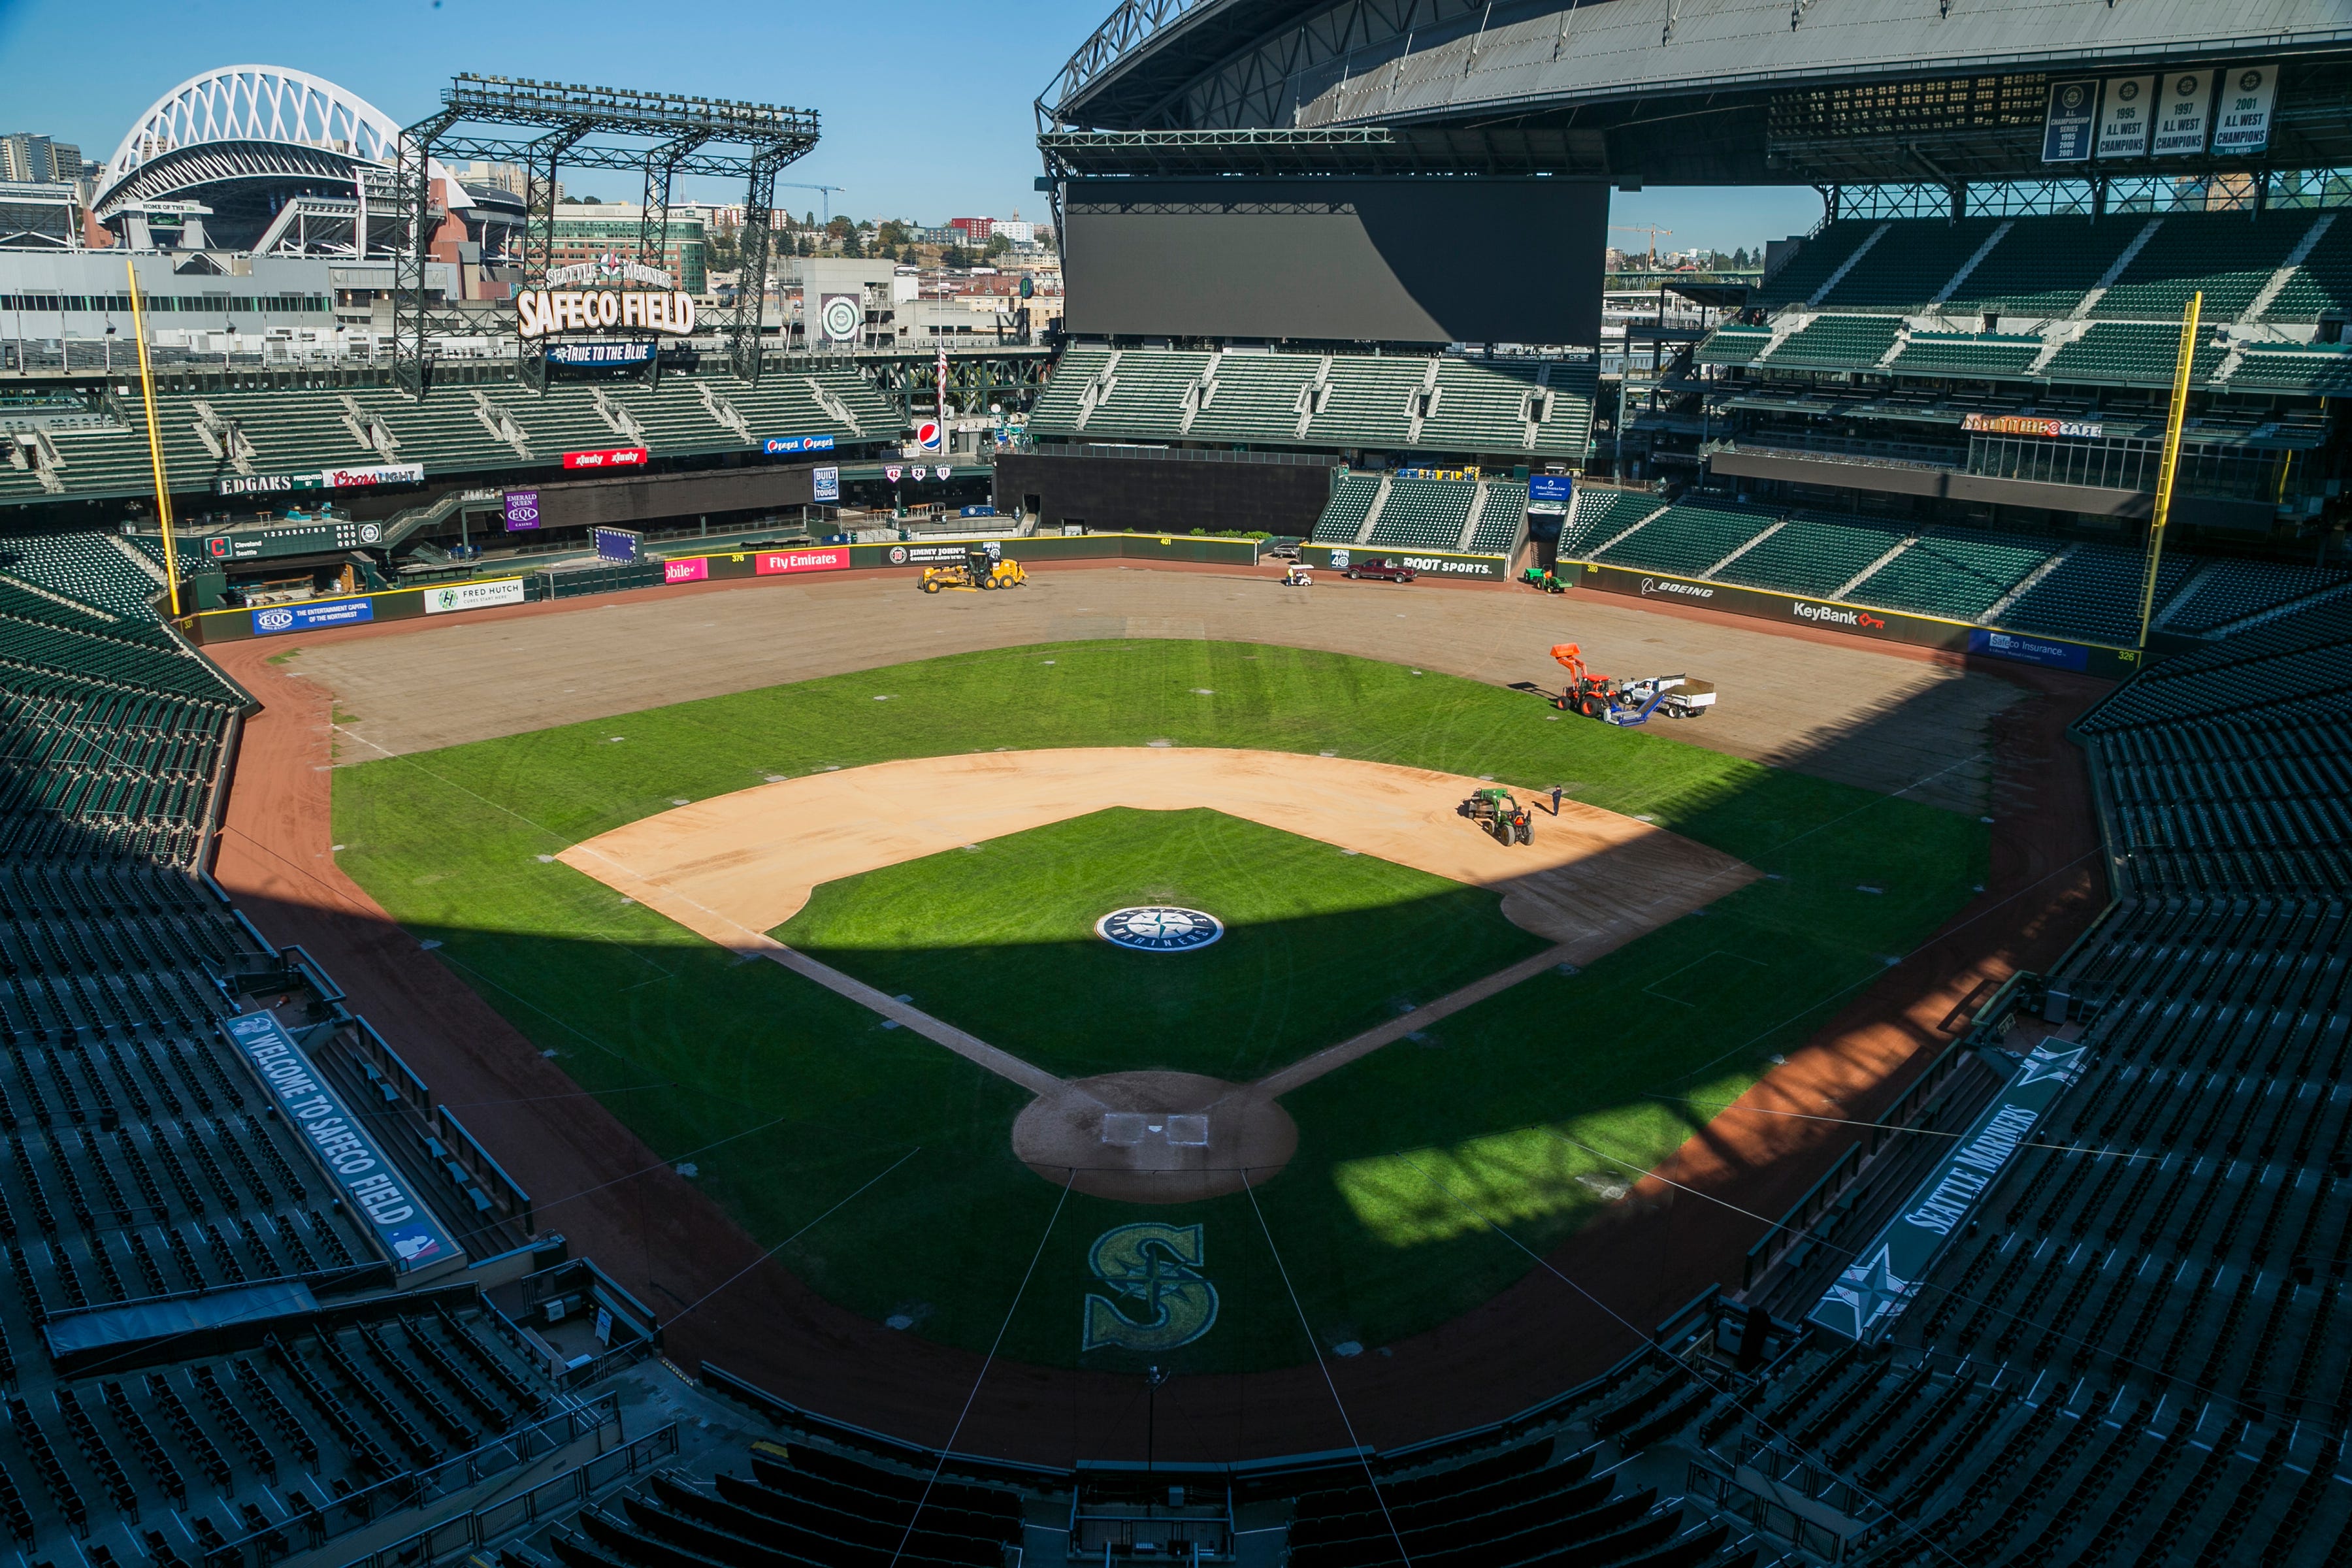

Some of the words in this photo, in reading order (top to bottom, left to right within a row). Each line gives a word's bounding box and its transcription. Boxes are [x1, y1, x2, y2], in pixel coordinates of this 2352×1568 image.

[2174, 103, 2193, 115] 1997
[2235, 98, 2257, 110] 2001
[2117, 107, 2136, 119] 1995
[2224, 116, 2238, 127] A.L.
[2240, 113, 2263, 126] WEST
[2051, 117, 2090, 125] CHAMPIONSHIP
[2163, 120, 2176, 132] A.L.
[2178, 118, 2200, 131] WEST
[2106, 124, 2119, 135] A.L.
[2121, 122, 2142, 135] WEST
[2156, 135, 2202, 149] CHAMPIONS
[2217, 130, 2265, 144] CHAMPIONS
[2100, 139, 2144, 152] CHAMPIONS
[546, 263, 597, 289] SEATTLE
[623, 260, 673, 289] MARINERS
[517, 289, 619, 338] SAFECO
[621, 290, 695, 335] FIELD
[566, 344, 591, 361] TRUE
[593, 347, 604, 360] TO
[606, 346, 623, 360] THE
[625, 343, 648, 360] BLUE
[576, 454, 604, 466] xfinity
[612, 451, 638, 463] xfinity
[333, 470, 378, 487] Coors
[378, 471, 416, 483] LIGHT
[816, 470, 836, 480] BUILT
[512, 499, 532, 508] QUEEN
[510, 508, 538, 521] EQC
[909, 548, 937, 557] JIMMY
[938, 547, 966, 555] JOHN'S
[770, 557, 788, 569] Fly
[791, 554, 836, 566] Emirates
[1403, 557, 1441, 570] ROOT
[1441, 562, 1489, 574] SPORTS
[1587, 564, 1598, 573] 380
[463, 588, 486, 598] FRED
[489, 585, 519, 595] HUTCH
[1658, 581, 1714, 598] BOEING
[308, 605, 347, 615] ENTERTAINMENT
[327, 612, 357, 620] NORTHWEST
[1793, 602, 1857, 625] KeyBank
[184, 621, 193, 629] 331
[261, 613, 293, 626] EQC
[1992, 636, 2019, 648] Safeco
[2022, 641, 2062, 655] Insurance
[2118, 651, 2134, 661] 326
[1111, 928, 1209, 947] MARINERS
[245, 1032, 318, 1100] WELCOME
[291, 1094, 333, 1119] TO
[307, 1117, 376, 1175] SAFECO
[1904, 1166, 1991, 1236] SEATTLE
[1953, 1103, 2039, 1174] MARINERS
[348, 1173, 414, 1225] FIELD
